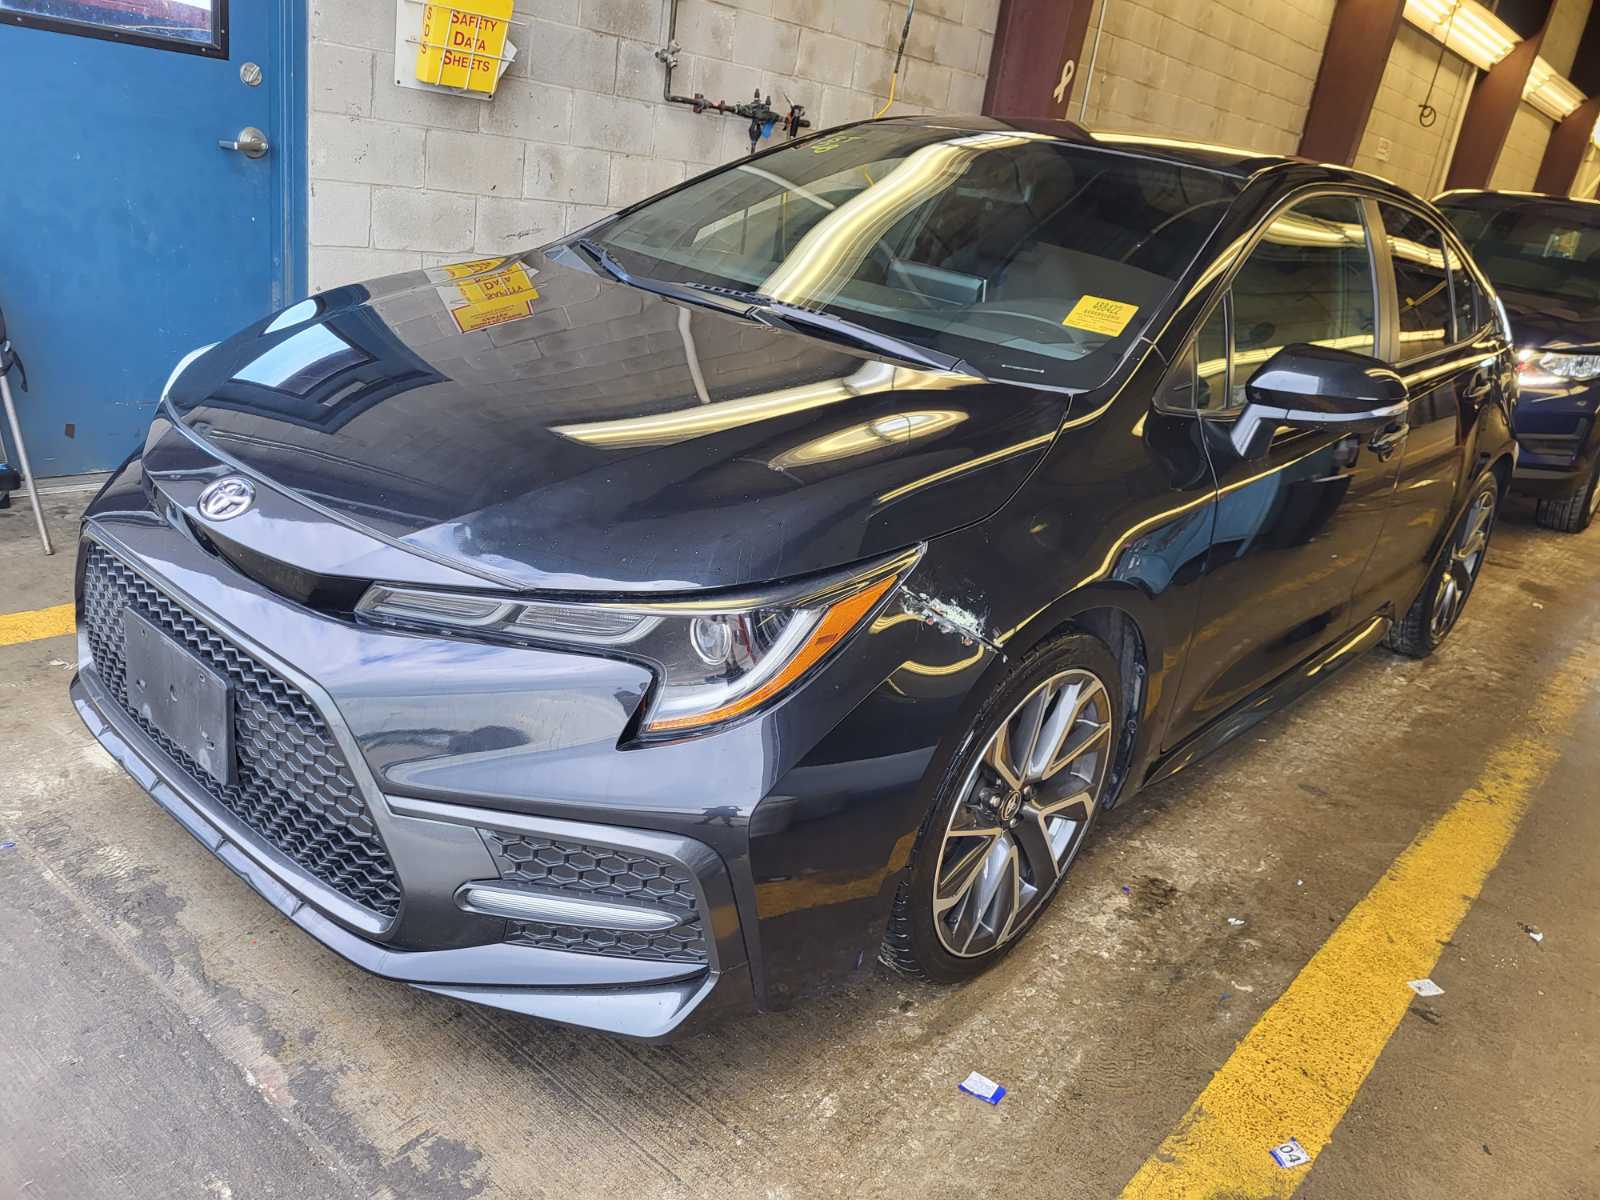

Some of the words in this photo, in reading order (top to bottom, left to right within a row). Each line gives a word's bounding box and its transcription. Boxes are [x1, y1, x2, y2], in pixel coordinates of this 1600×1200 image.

[451, 10, 498, 32] SAFETY
[443, 49, 490, 72] SHEETS
[1279, 1145, 1301, 1162] 04
